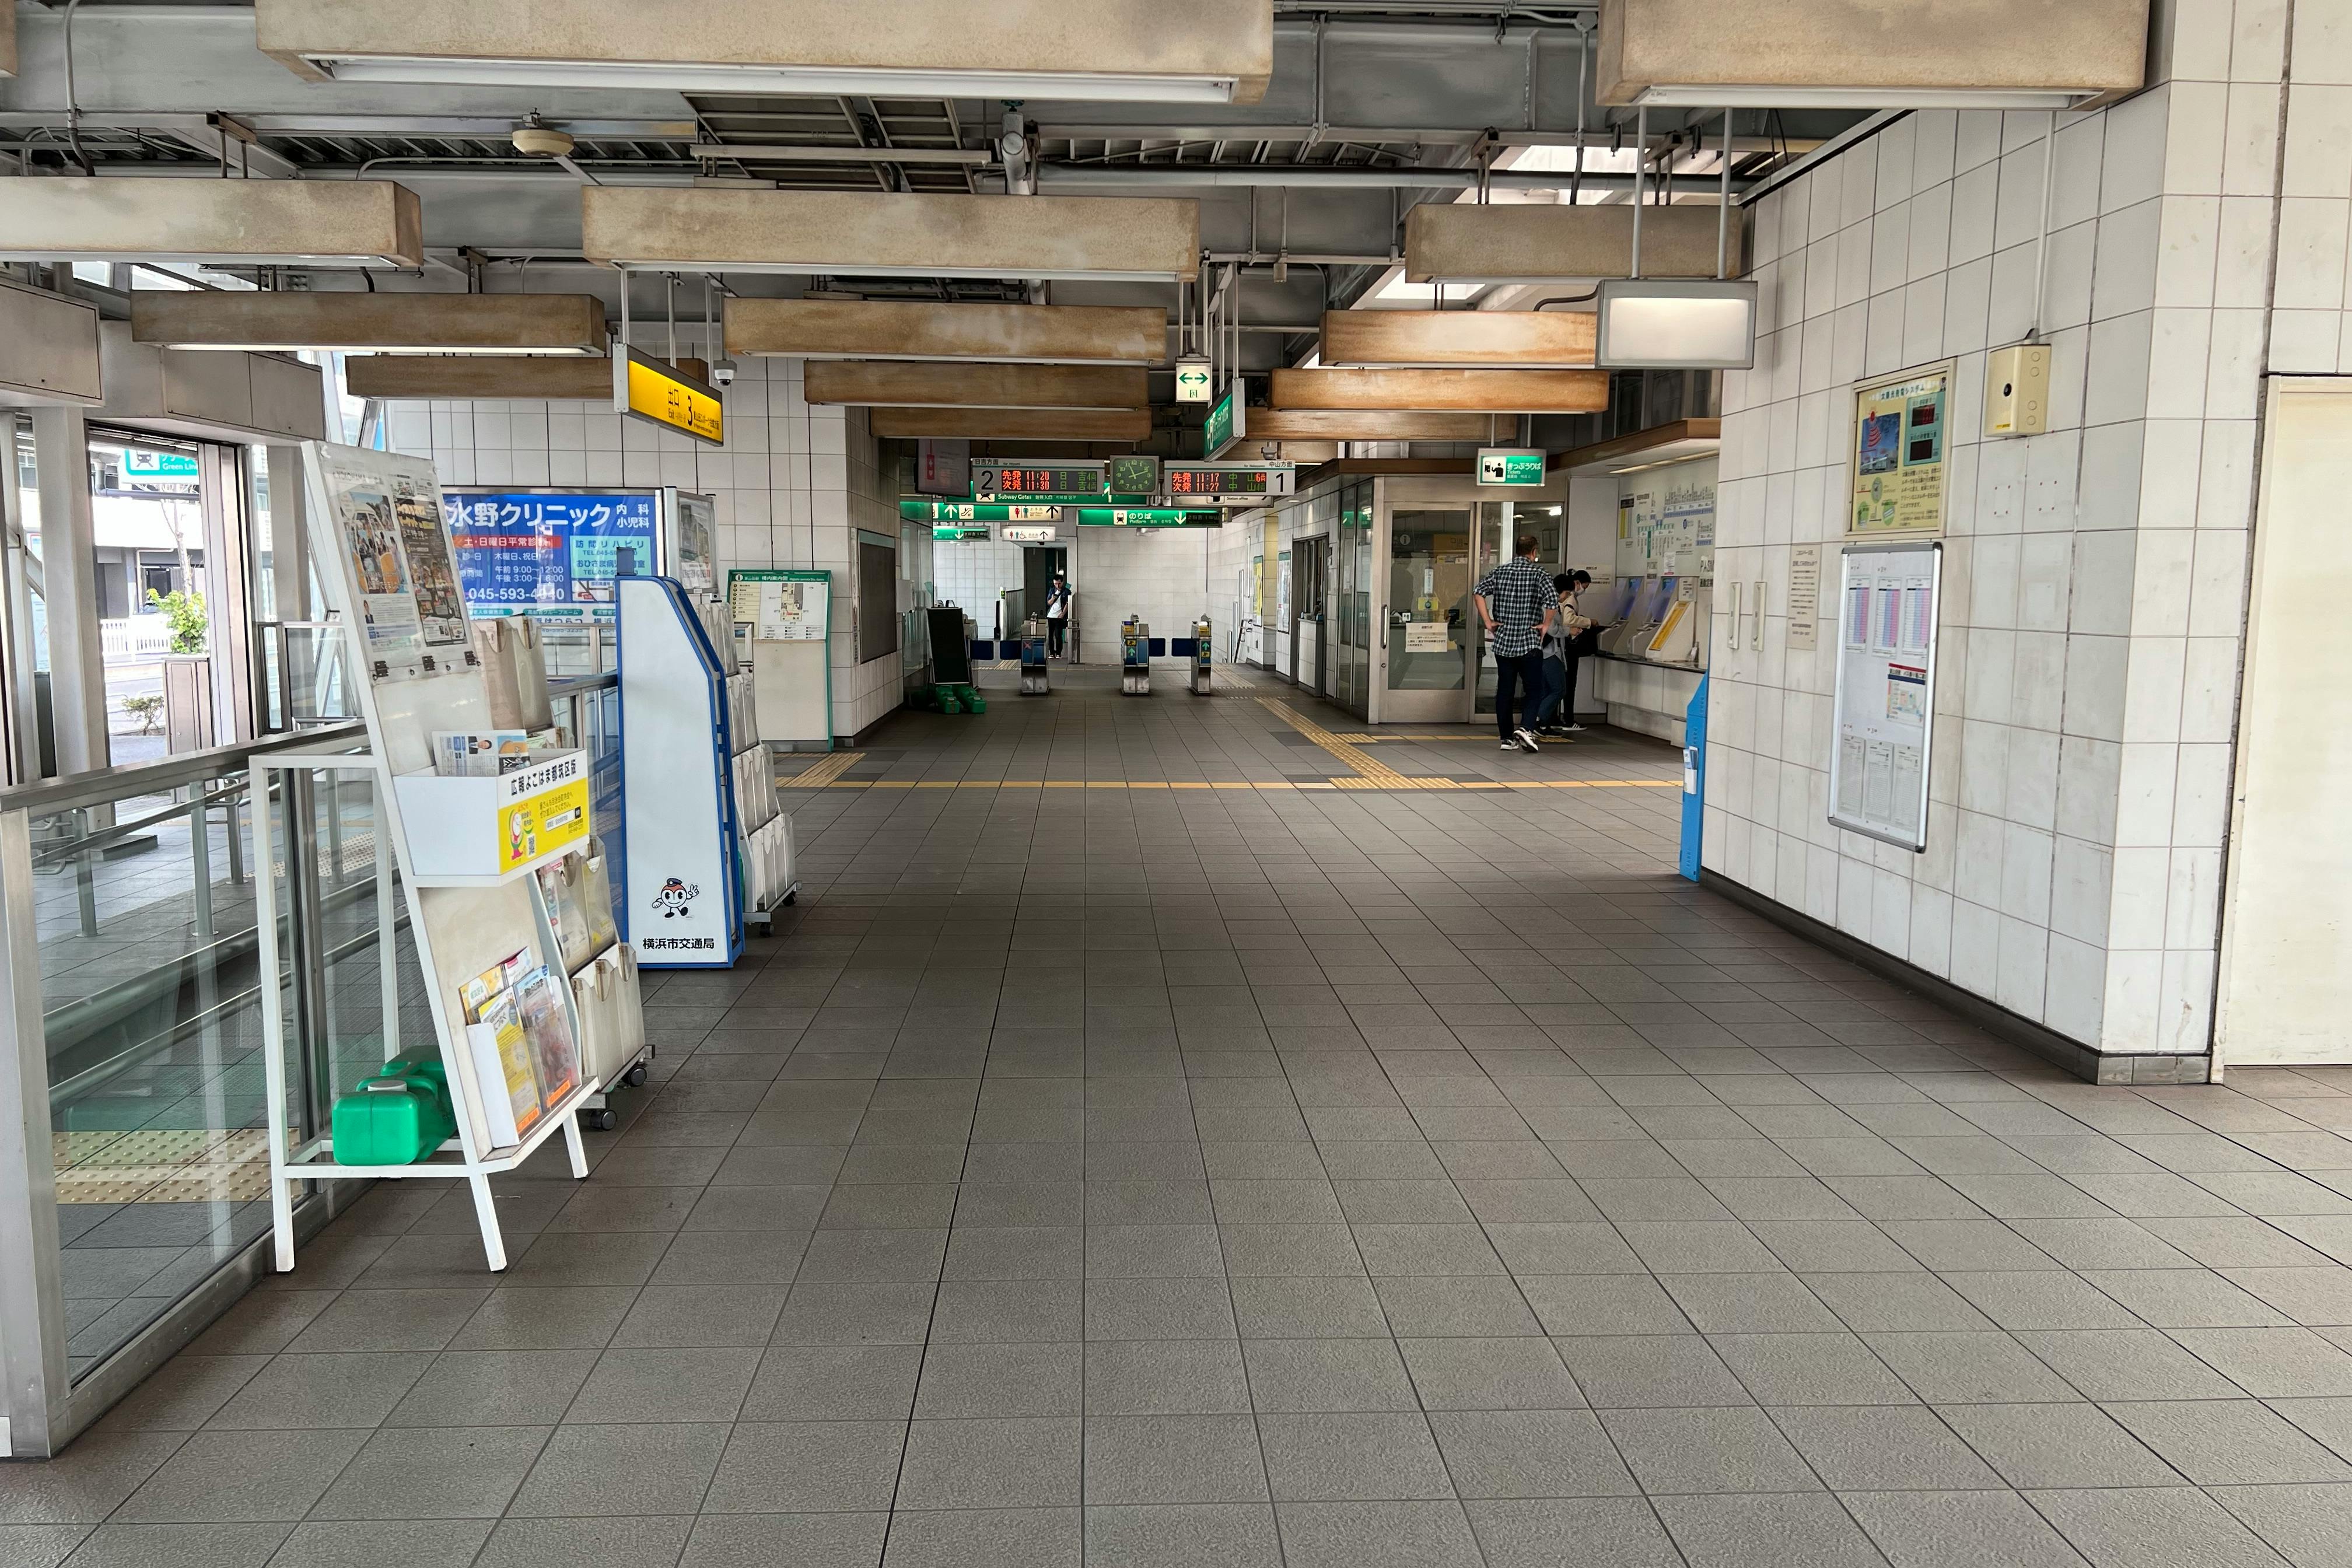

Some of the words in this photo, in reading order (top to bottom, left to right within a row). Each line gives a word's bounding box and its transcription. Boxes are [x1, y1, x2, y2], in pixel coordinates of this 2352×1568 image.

[688, 395, 692, 426] 3
[1507, 462, 1541, 470] きっぷうりば
[981, 470, 993, 490] 2
[1002, 470, 1021, 480] 先発
[1027, 471, 1049, 480] 11:20
[1172, 472, 1191, 482] 先発
[1196, 473, 1219, 482] 11:17
[1003, 480, 1021, 490] 次発
[1027, 481, 1049, 490] 11:30
[1172, 482, 1191, 492] 次発
[1196, 482, 1219, 492] 11:27
[1276, 473, 1283, 492] 1
[447, 502, 610, 527] 水野クリニック
[616, 517, 649, 528] 小児科
[642, 937, 715, 950] 横浜市交通局
